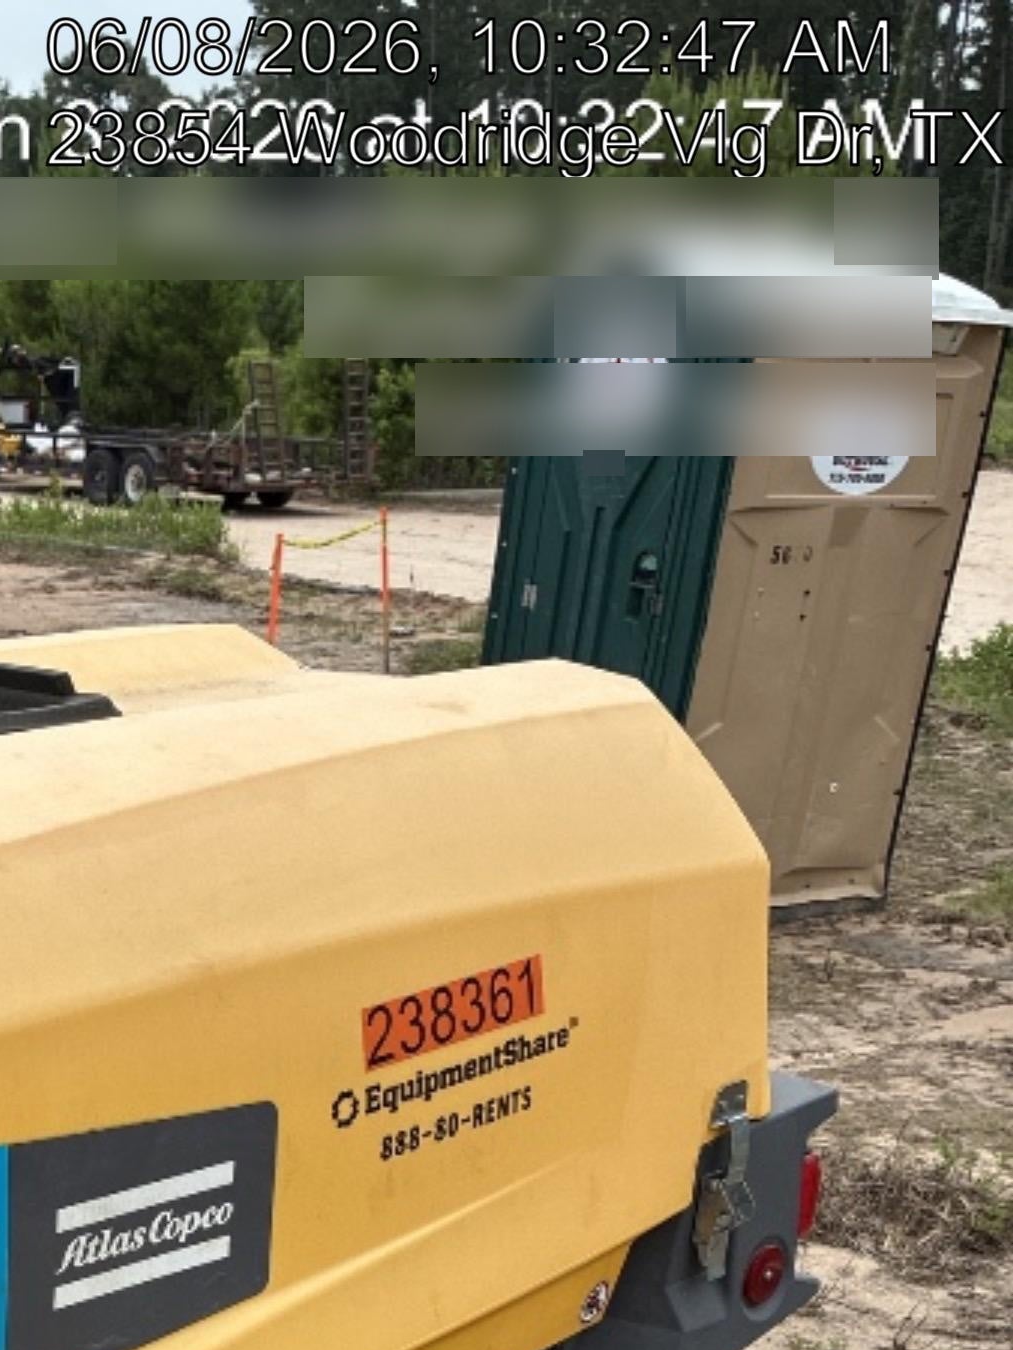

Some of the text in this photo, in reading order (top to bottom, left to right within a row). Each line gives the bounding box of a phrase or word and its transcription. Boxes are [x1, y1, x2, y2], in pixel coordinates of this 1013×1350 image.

[367, 957, 535, 1069] 238361
[55, 1201, 234, 1277] Atlas Copco
